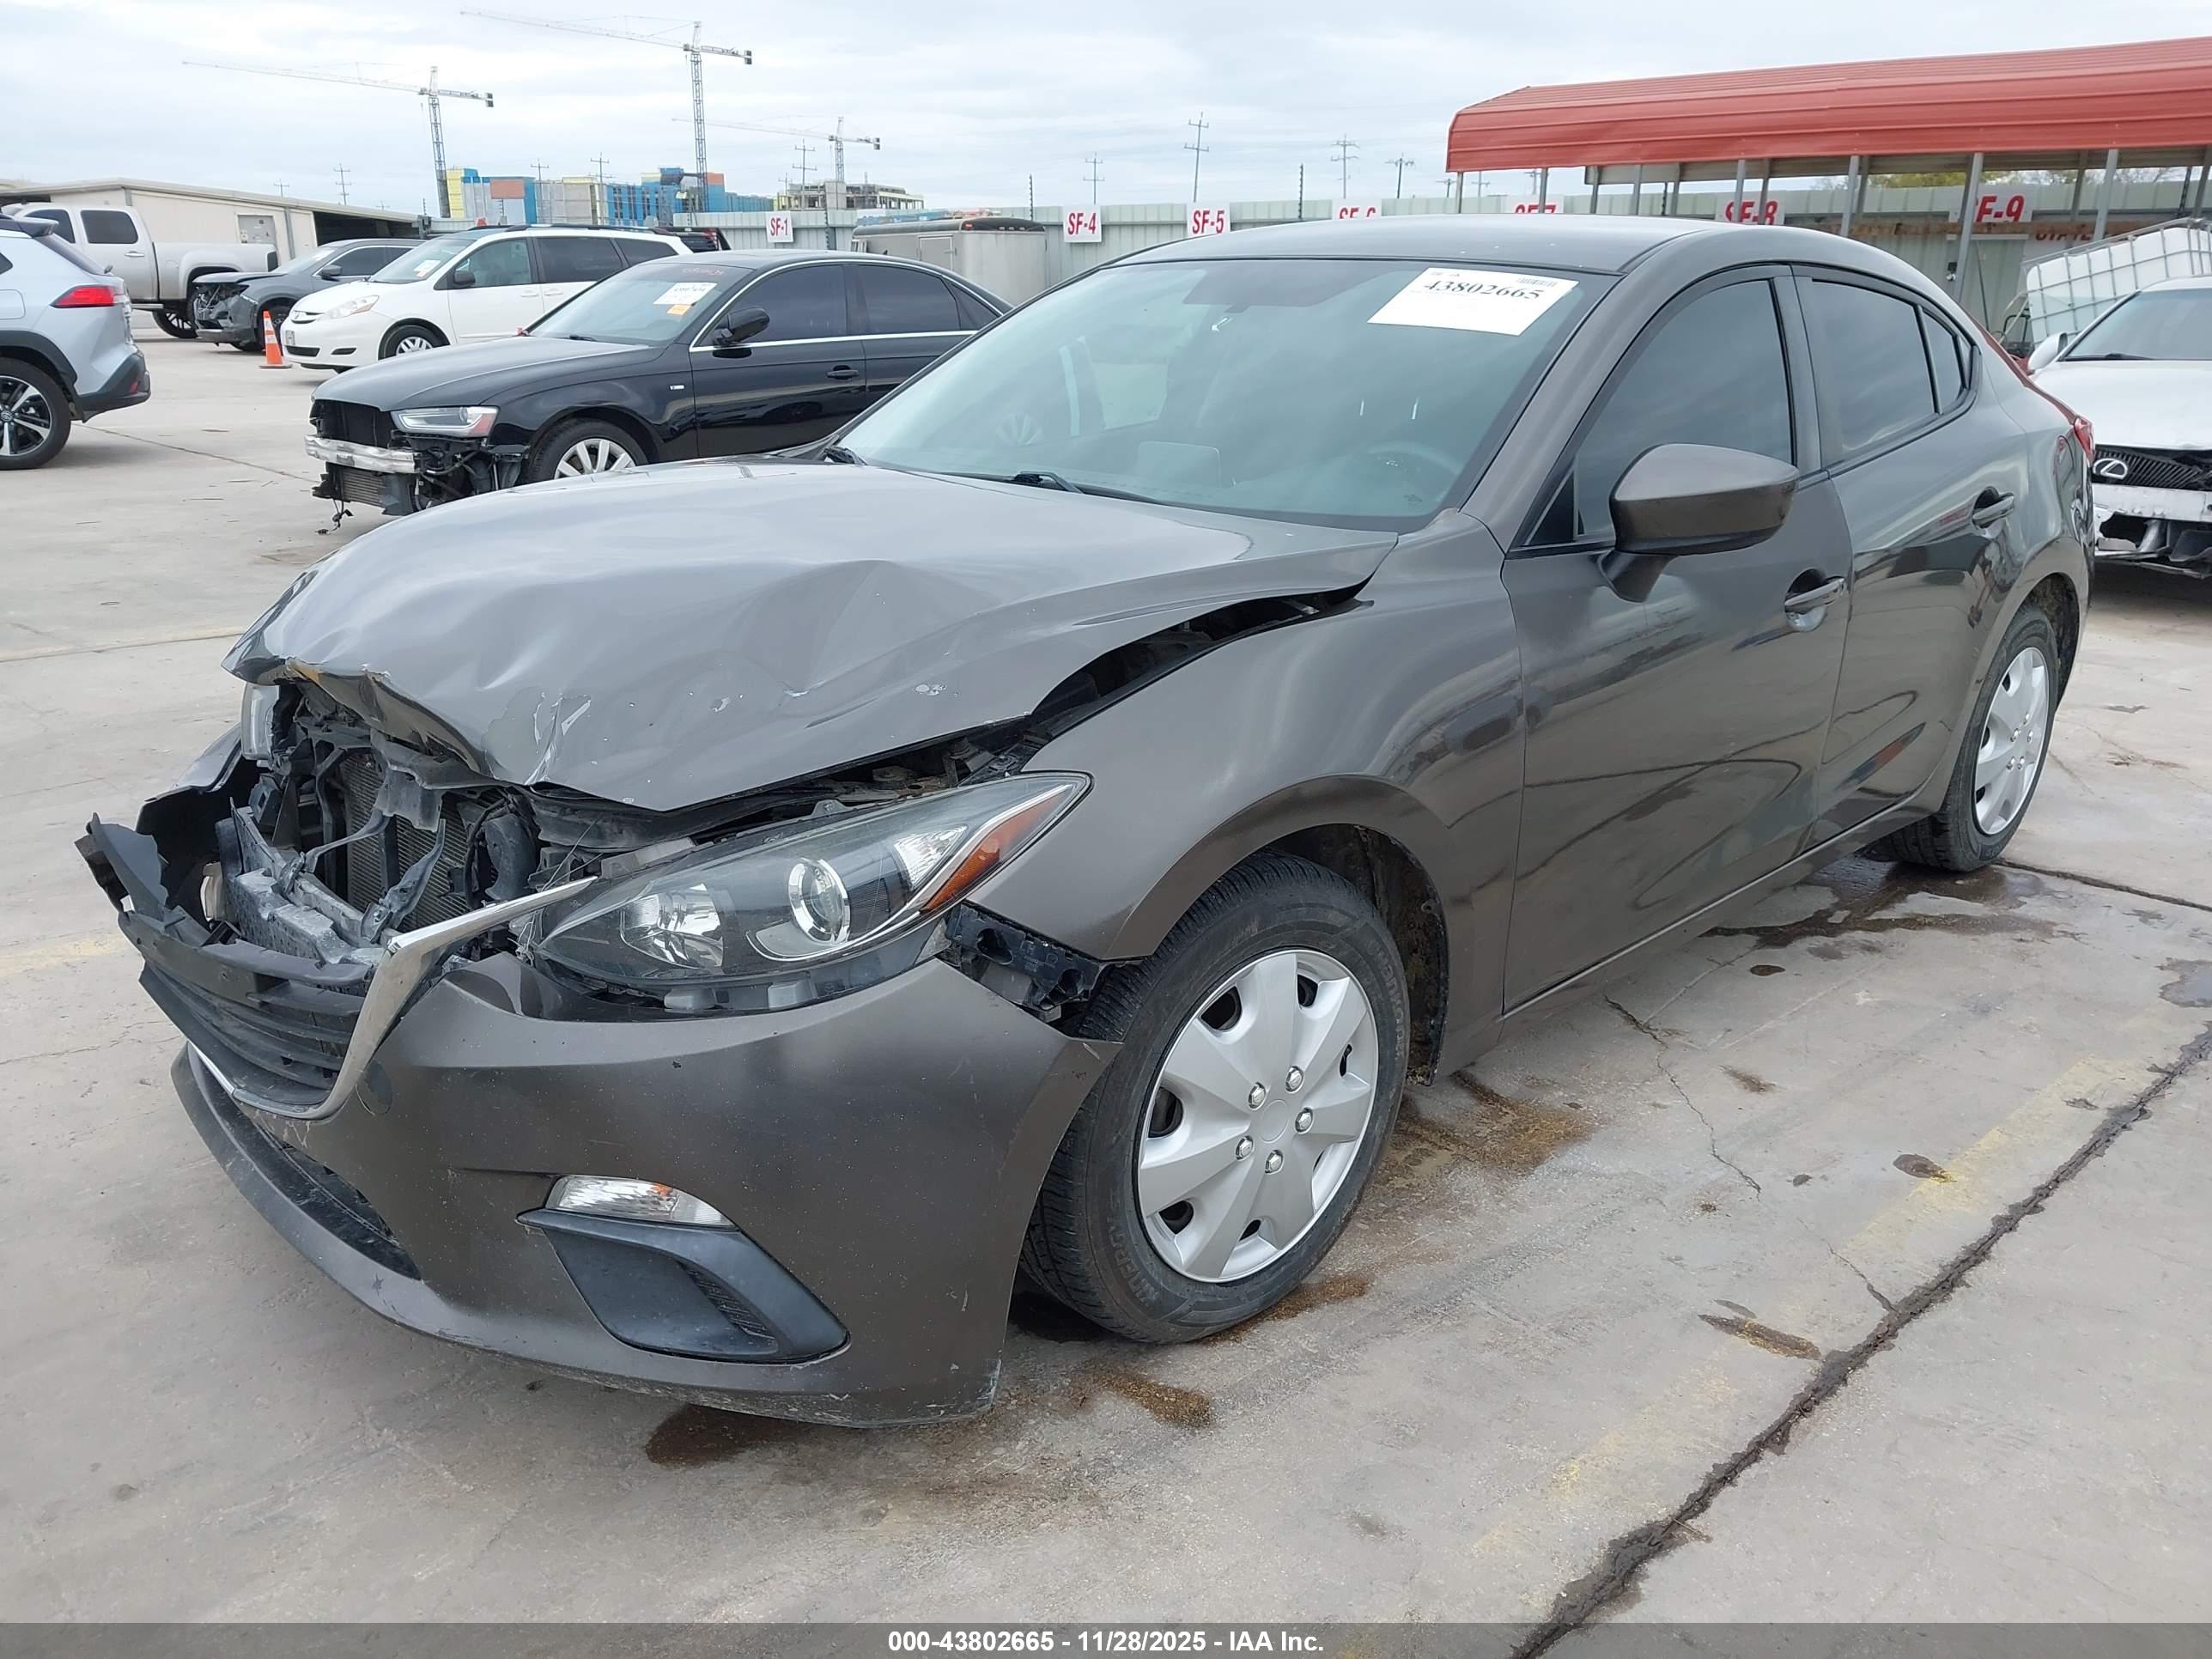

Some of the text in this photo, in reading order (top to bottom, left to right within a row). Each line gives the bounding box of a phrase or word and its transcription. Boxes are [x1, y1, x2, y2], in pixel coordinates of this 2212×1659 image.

[1976, 195, 2024, 222] F-9
[770, 217, 787, 236] SF-1
[1067, 212, 1096, 234] SF-4
[1192, 210, 1224, 234] SF-5
[1423, 280, 1545, 300] 43802665
